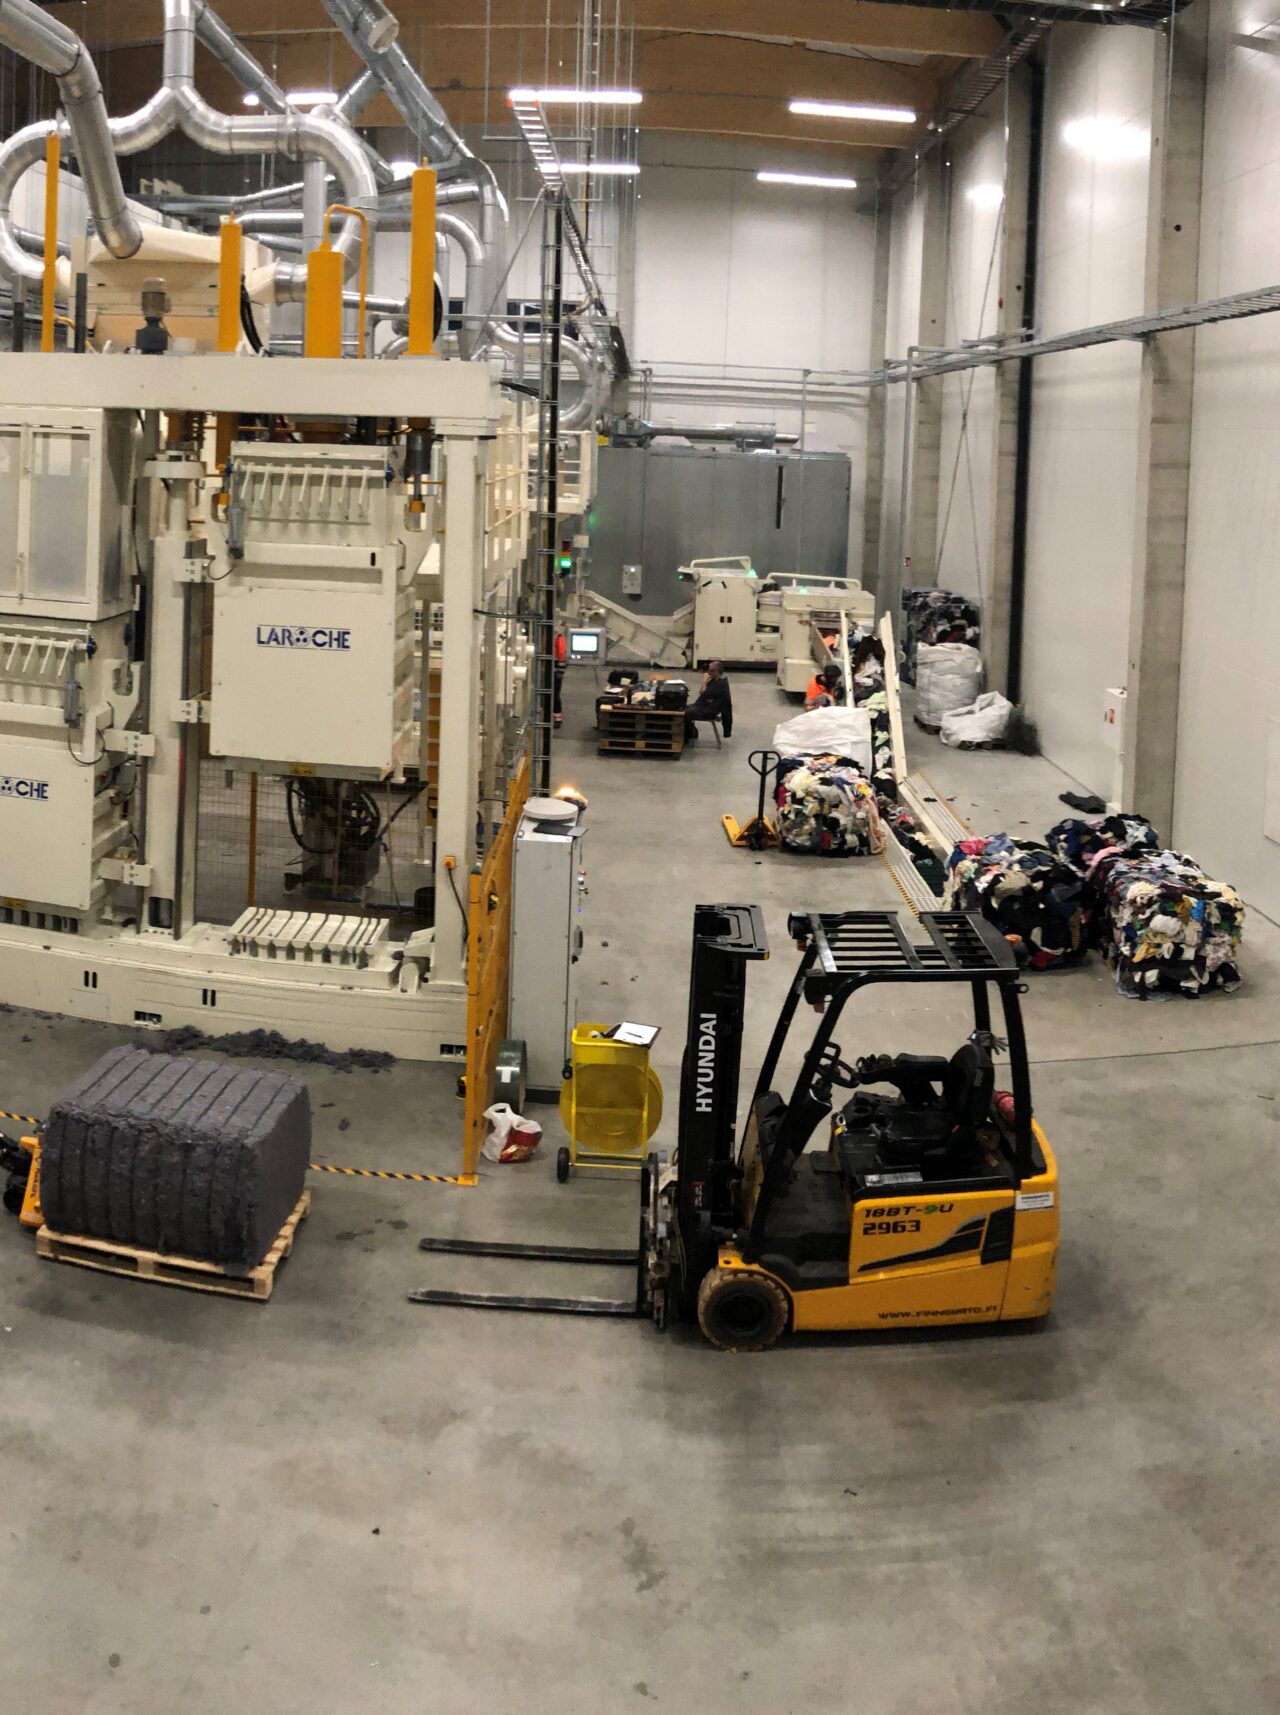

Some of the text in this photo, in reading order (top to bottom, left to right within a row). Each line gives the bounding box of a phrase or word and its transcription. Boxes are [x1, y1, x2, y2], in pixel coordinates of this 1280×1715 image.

[257, 627, 351, 649] LAROCHE
[696, 1013, 717, 1112] HYUNDAI
[862, 1220, 921, 1236] 2963
